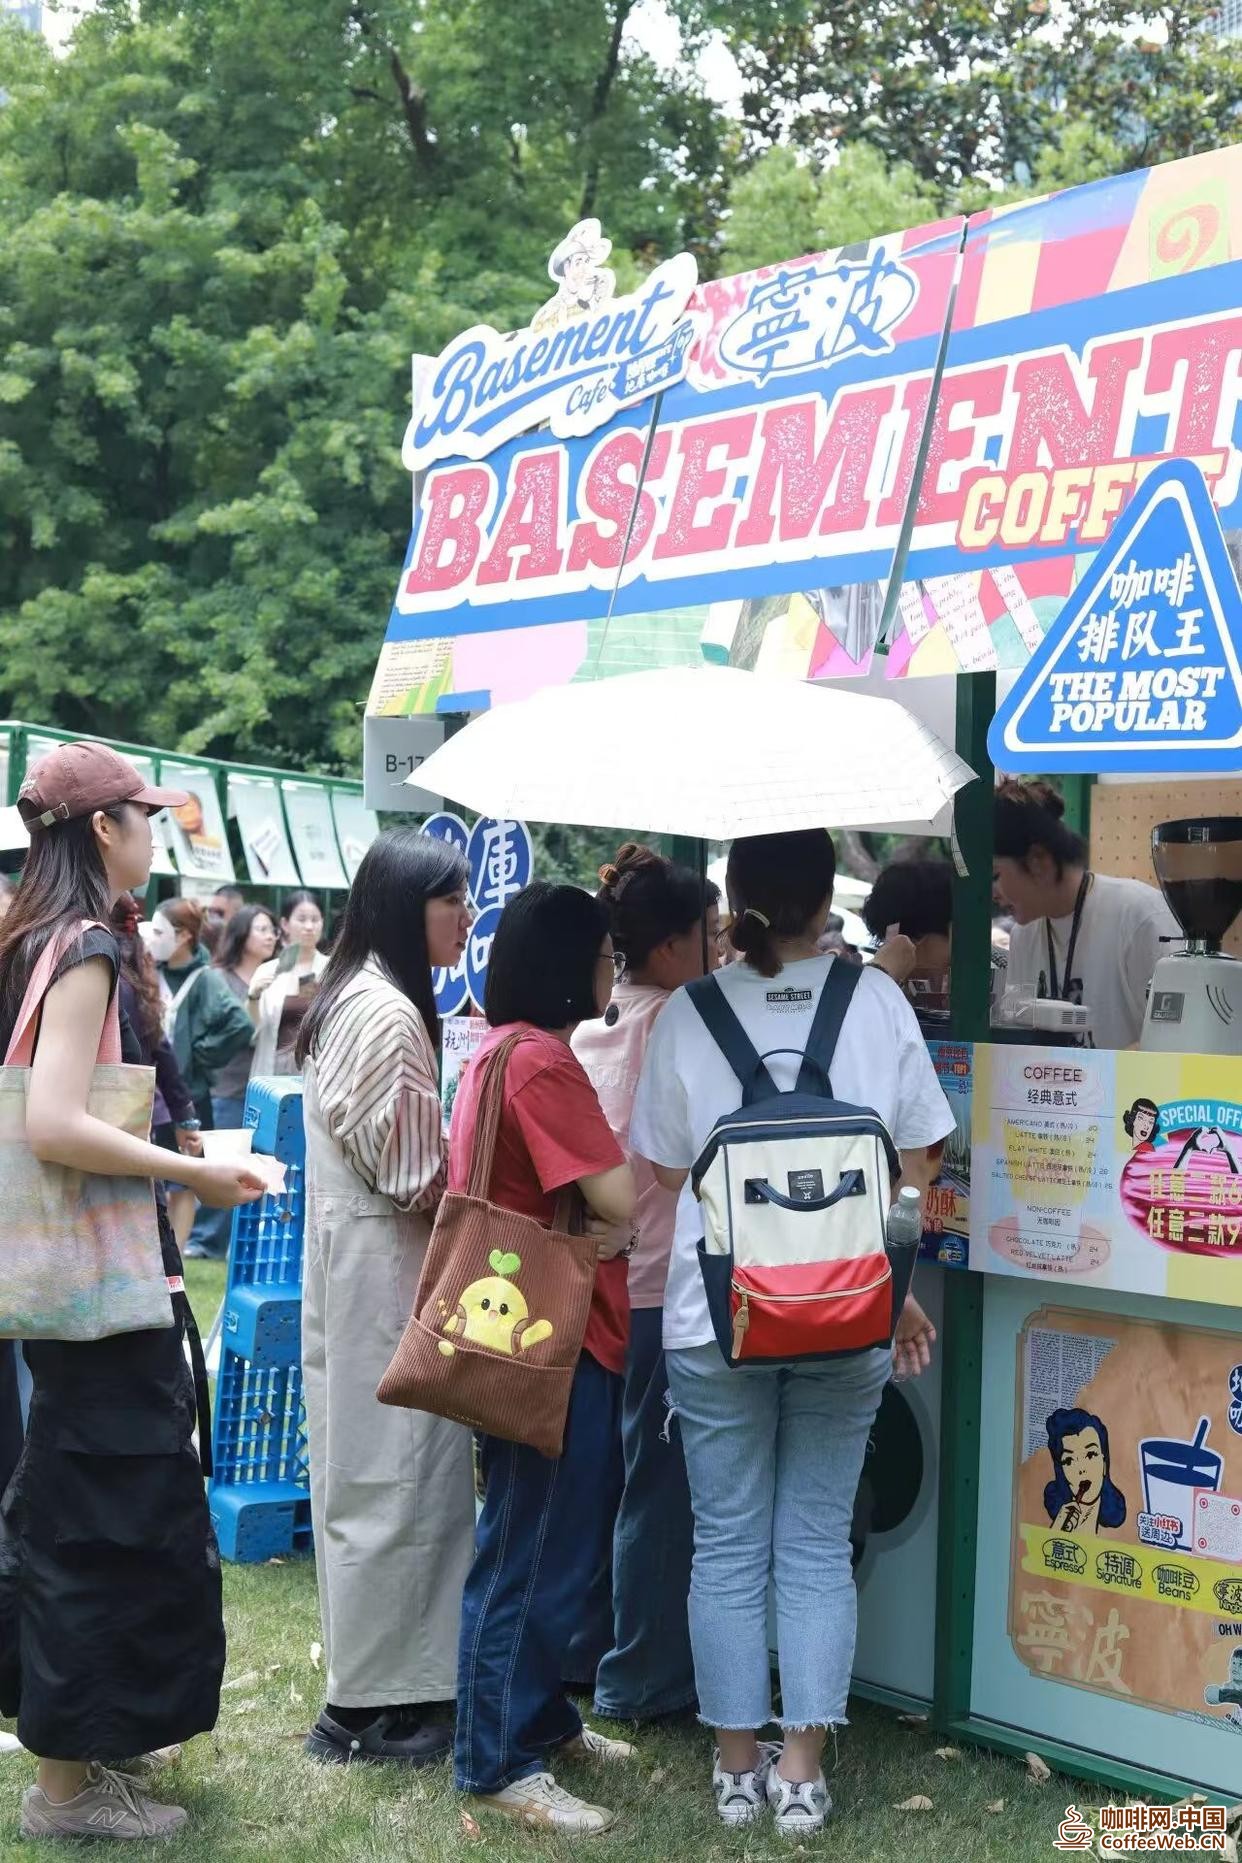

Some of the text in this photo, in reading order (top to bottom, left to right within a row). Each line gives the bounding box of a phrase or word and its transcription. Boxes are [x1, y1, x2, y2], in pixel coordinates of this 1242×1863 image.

[413, 280, 674, 450] Basement
[566, 374, 611, 416] Cafe
[405, 310, 1242, 595] BASEMENT
[958, 453, 1226, 547] COFF
[1110, 552, 1197, 611] 咖啡
[1077, 608, 1206, 665] 排队王
[1049, 666, 1226, 703] THE MOST
[1049, 699, 1208, 733] POPULAR
[1023, 1066, 1083, 1083] COFFEE
[1027, 1088, 1078, 1107] 经典意式
[1161, 1104, 1242, 1131] SPECIAL OFF
[1026, 1205, 1072, 1217] NON-COFFEE
[1005, 1236, 1044, 1247] CHOCOLATE
[1010, 1248, 1024, 1257] RED
[1139, 1514, 1179, 1532] 关注小红书
[1052, 1540, 1079, 1564] 意式
[1044, 1554, 1085, 1575] Espresso
[1104, 1552, 1135, 1577] 特调
[1096, 1567, 1142, 1589] Signature
[1157, 1567, 1195, 1591] 咖啡豆
[1158, 1582, 1192, 1601] Beans
[1218, 1623, 1232, 1636] OH
